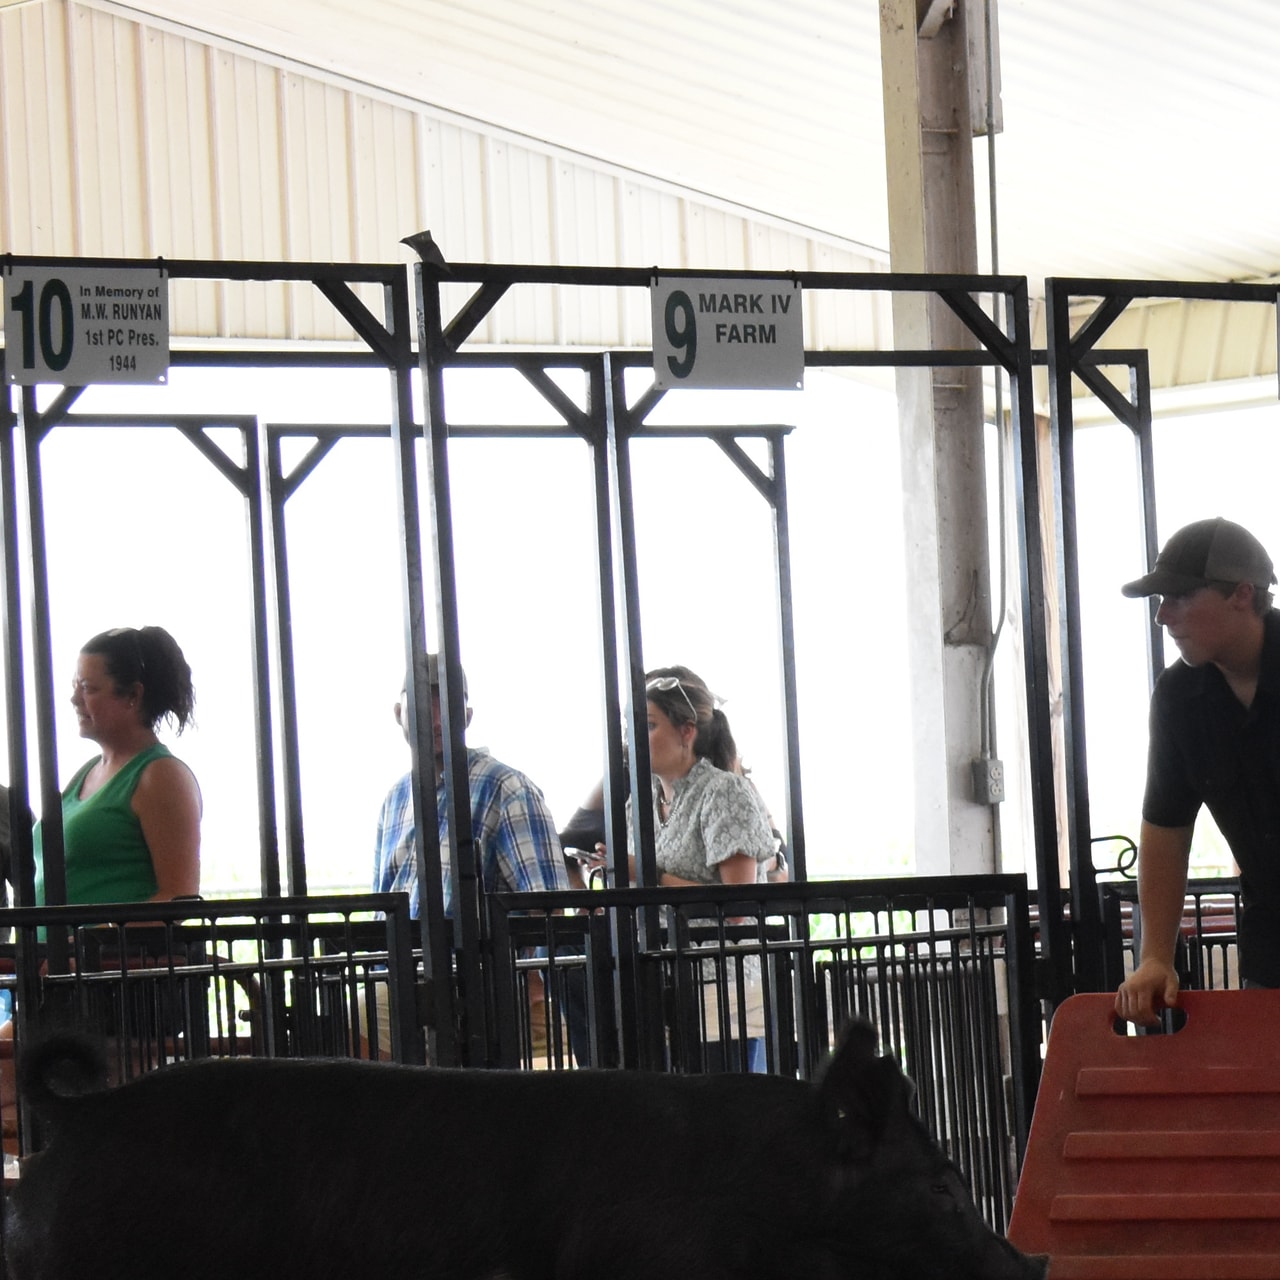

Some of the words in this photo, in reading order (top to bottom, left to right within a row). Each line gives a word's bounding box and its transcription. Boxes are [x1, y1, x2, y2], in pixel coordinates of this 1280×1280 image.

[80, 286, 91, 297] In
[95, 286, 143, 300] Memory
[147, 286, 159, 297] of
[81, 303, 108, 320] M.W.
[113, 303, 162, 321] RUNYAN
[699, 293, 764, 314] MARK
[771, 294, 791, 314] IV
[11, 278, 74, 372] 10
[664, 290, 697, 379] 9
[715, 324, 776, 344] FARM
[85, 330, 104, 346] 1st
[108, 329, 124, 346] PC
[128, 329, 159, 346] Pres.
[109, 355, 137, 372] 1944
